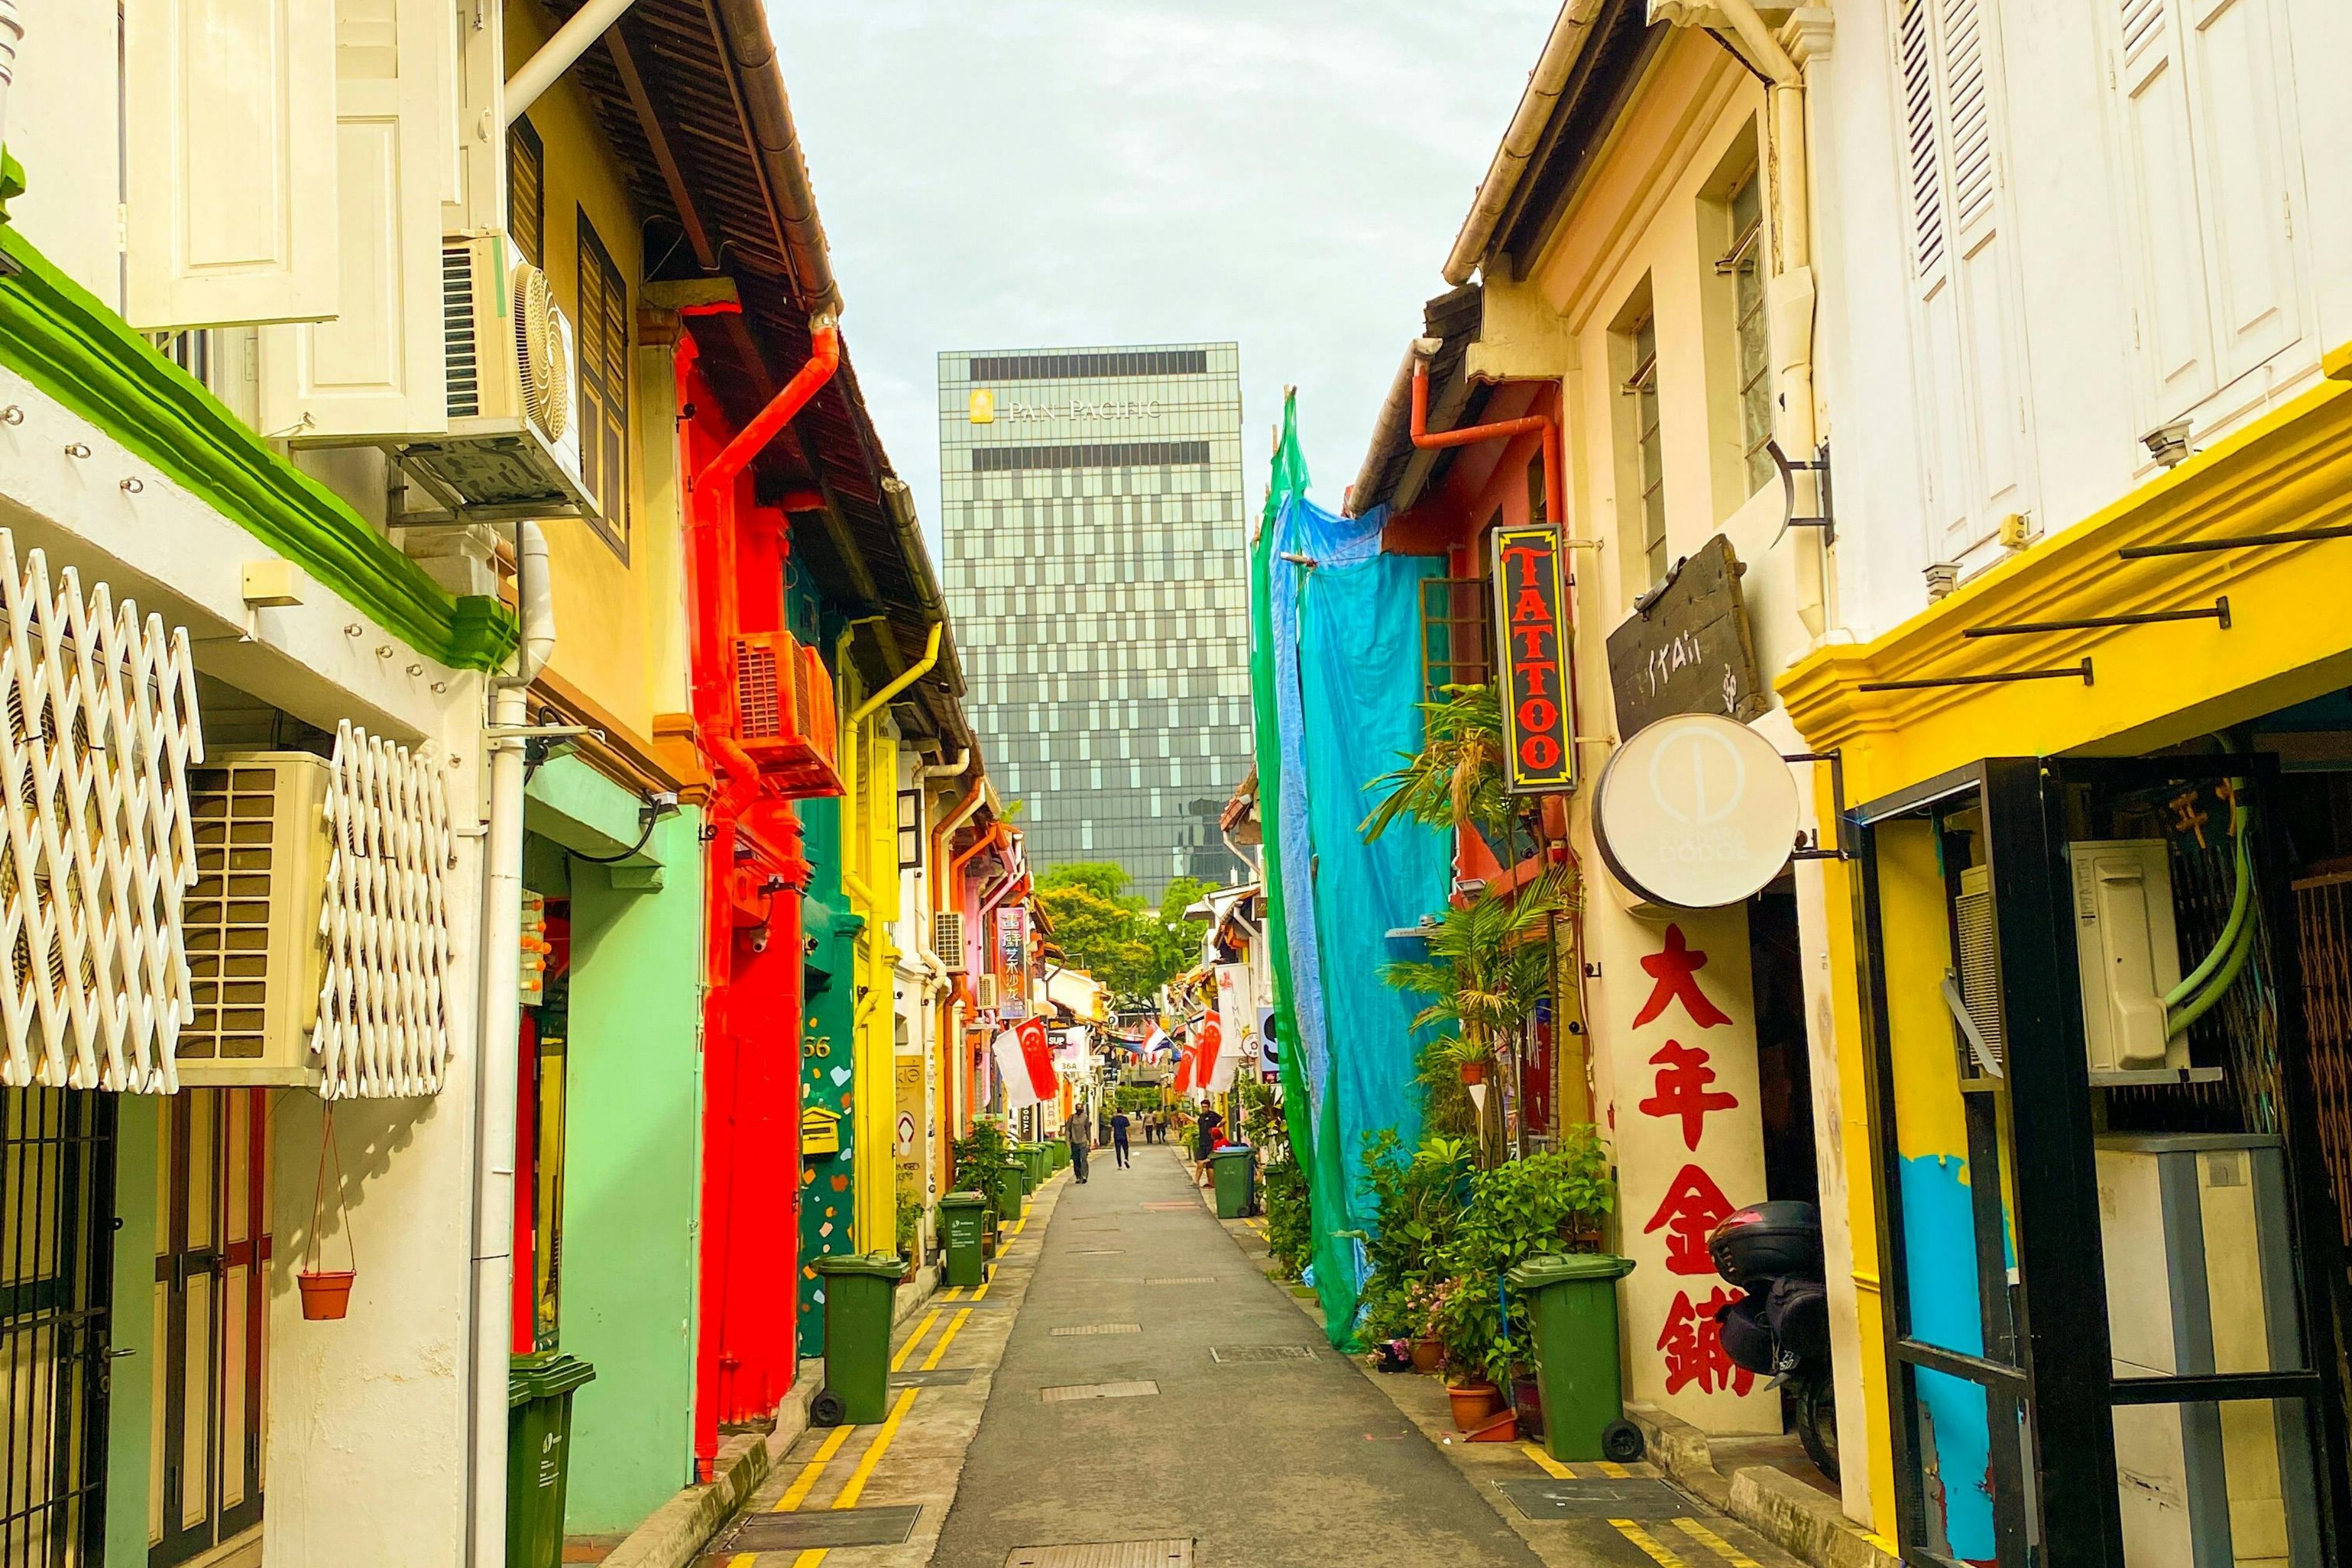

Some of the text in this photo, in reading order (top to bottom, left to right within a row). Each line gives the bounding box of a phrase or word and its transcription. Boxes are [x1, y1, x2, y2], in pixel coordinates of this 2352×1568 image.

[1009, 400, 1161, 423] PAN PACIFIC
[1501, 546, 1560, 770] TATTOO
[1048, 1036, 1064, 1046] SUP
